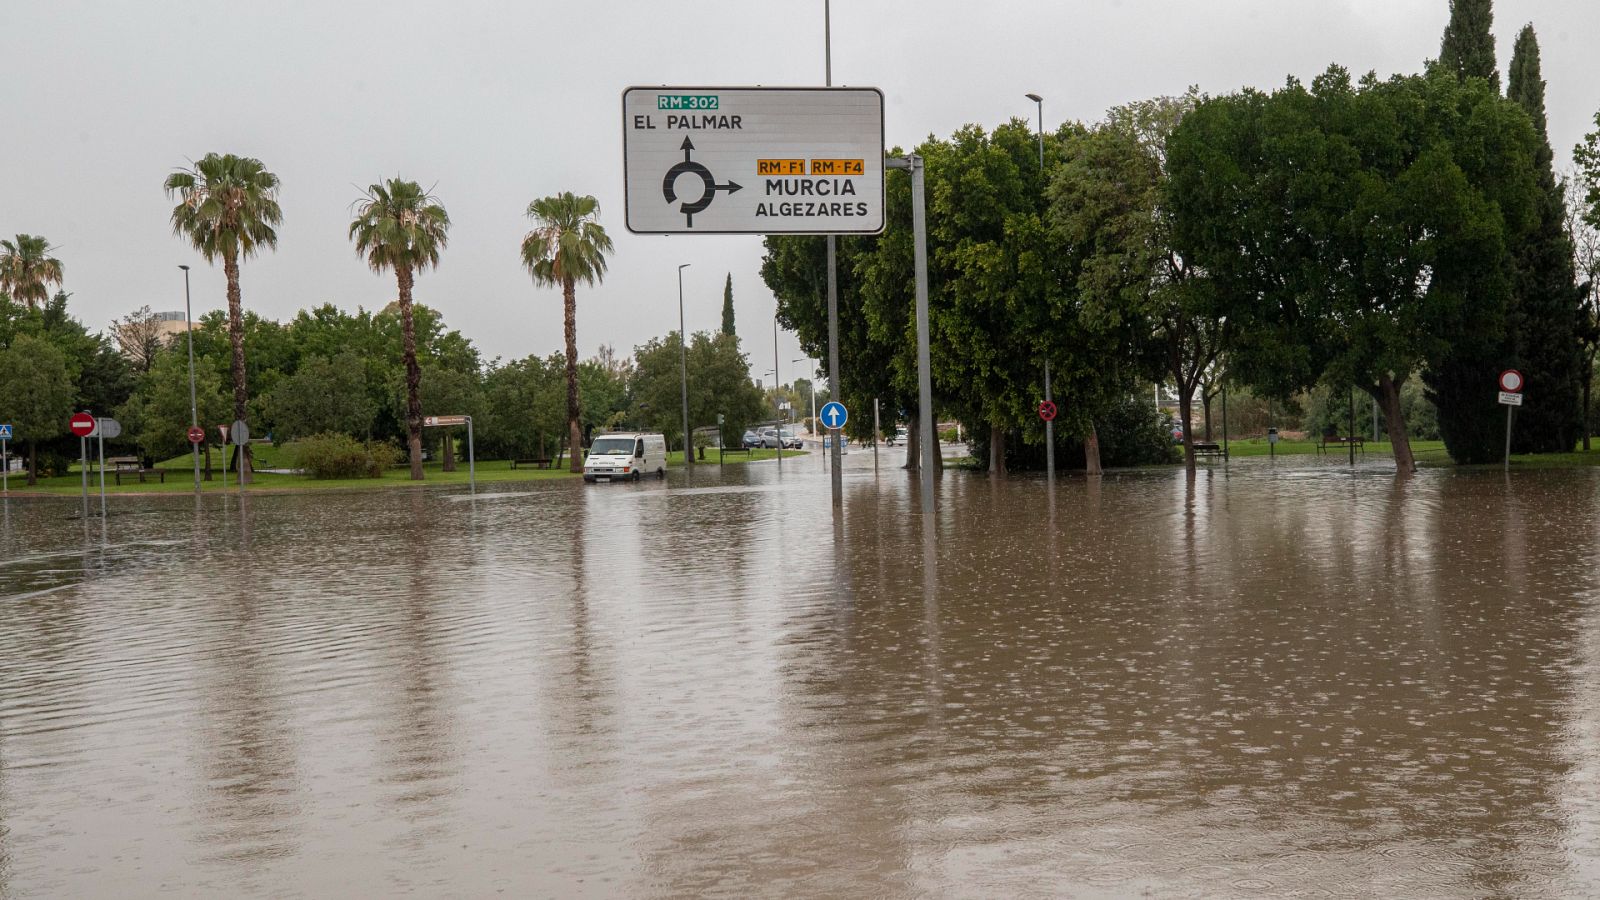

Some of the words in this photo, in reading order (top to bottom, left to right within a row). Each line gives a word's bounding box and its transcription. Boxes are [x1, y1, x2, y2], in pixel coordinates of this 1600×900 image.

[659, 96, 718, 109] RM-302
[634, 115, 656, 129] EL
[667, 115, 742, 129] PALMAR
[766, 179, 856, 196] MURCIA
[755, 203, 868, 217] ALGEZARES
